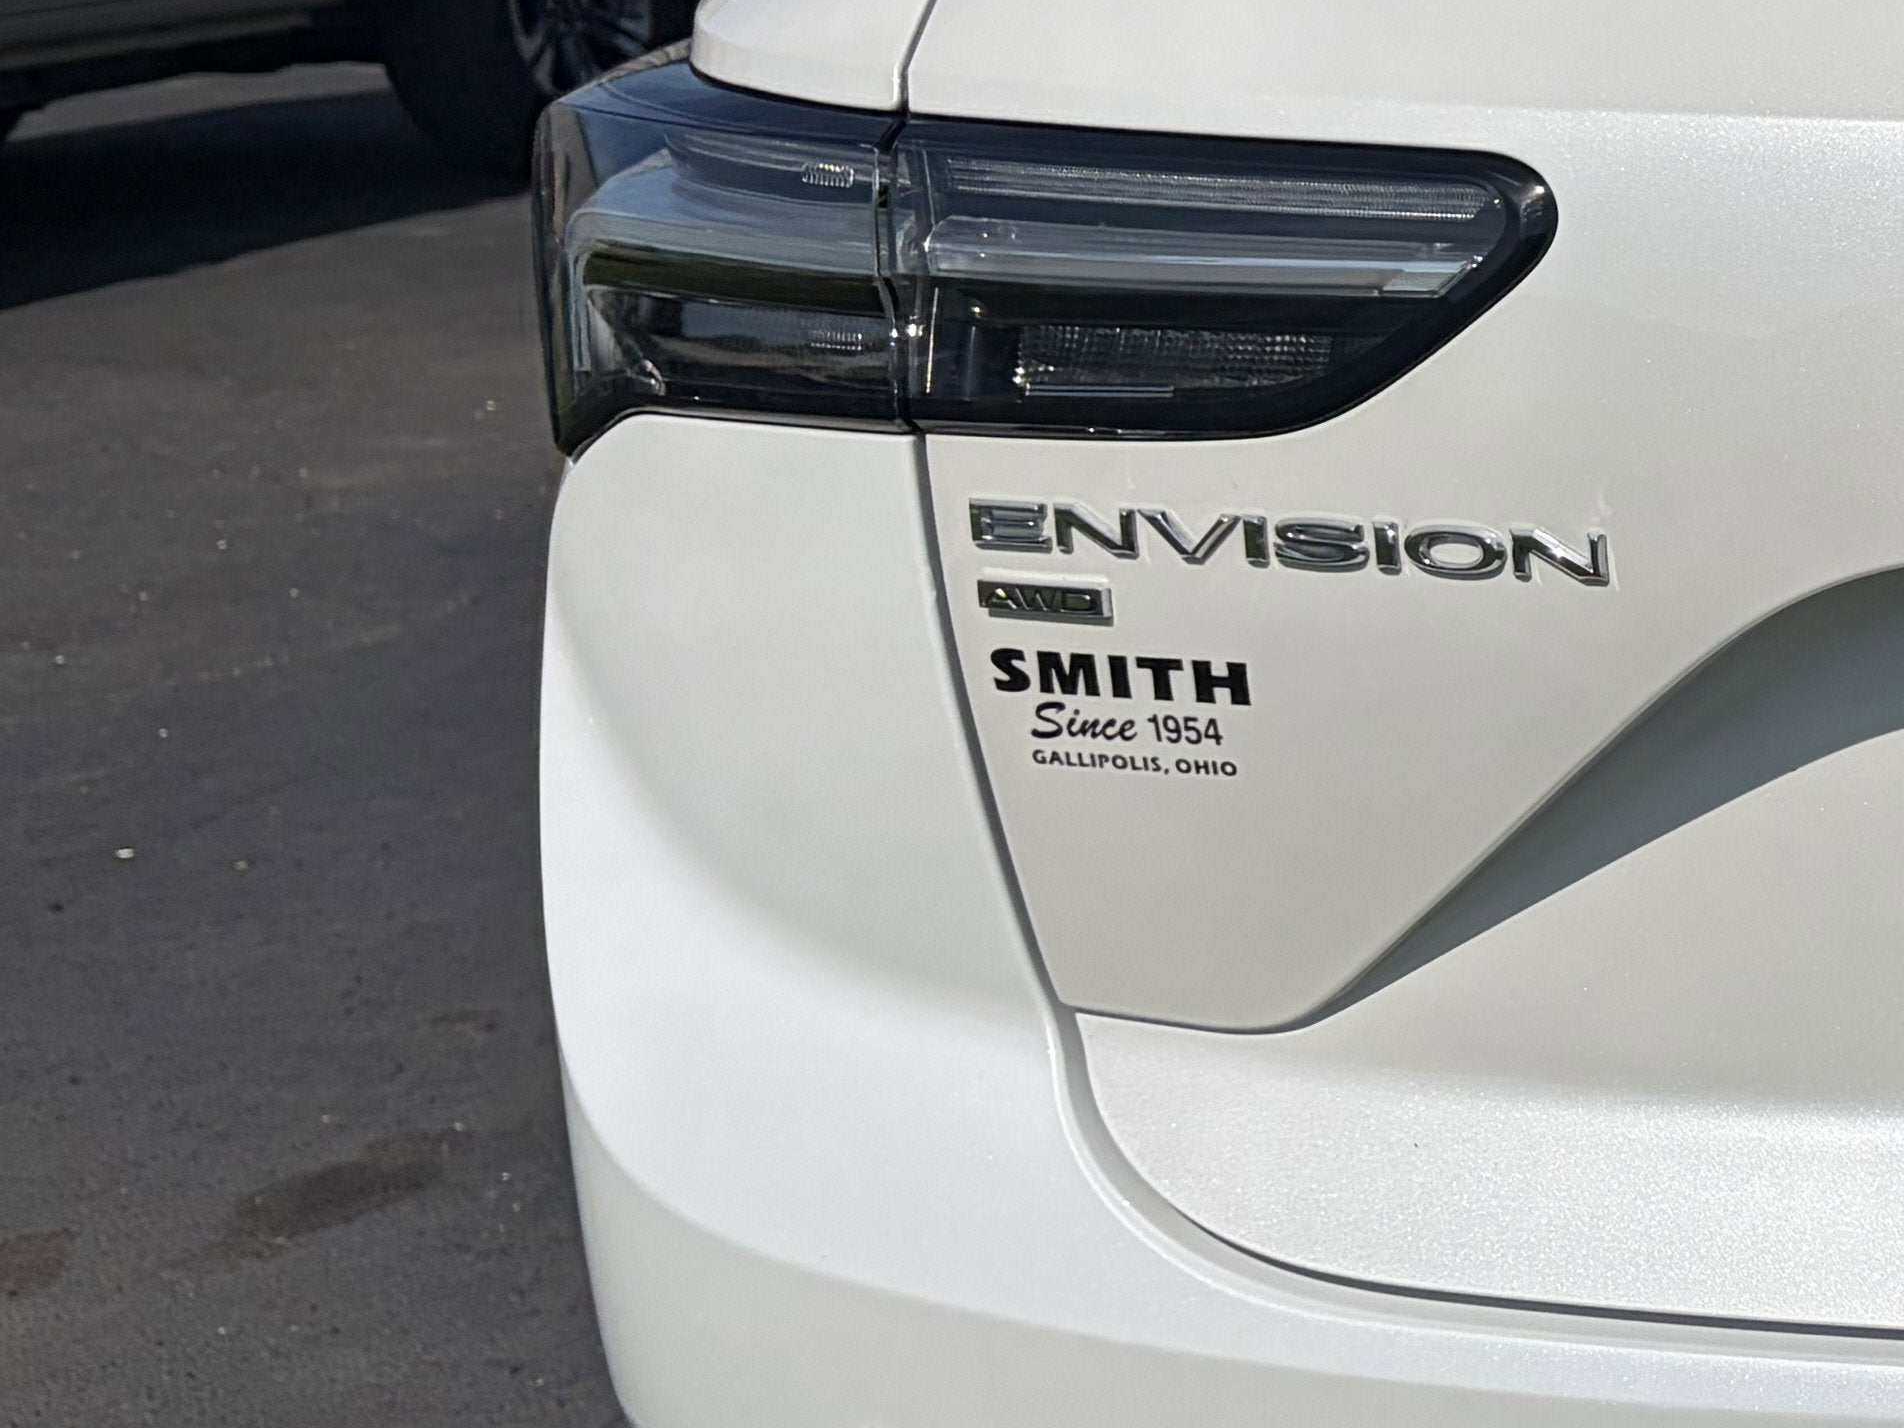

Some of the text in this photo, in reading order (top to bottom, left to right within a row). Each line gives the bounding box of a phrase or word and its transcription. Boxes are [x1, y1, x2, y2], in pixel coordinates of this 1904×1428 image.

[968, 497, 1611, 587] ENVISION
[982, 584, 1099, 615] AWD
[990, 647, 1252, 706] SMITH
[1031, 701, 1224, 746] Since 1954
[1032, 748, 1238, 776] GALLIPOLIS, OHIO
